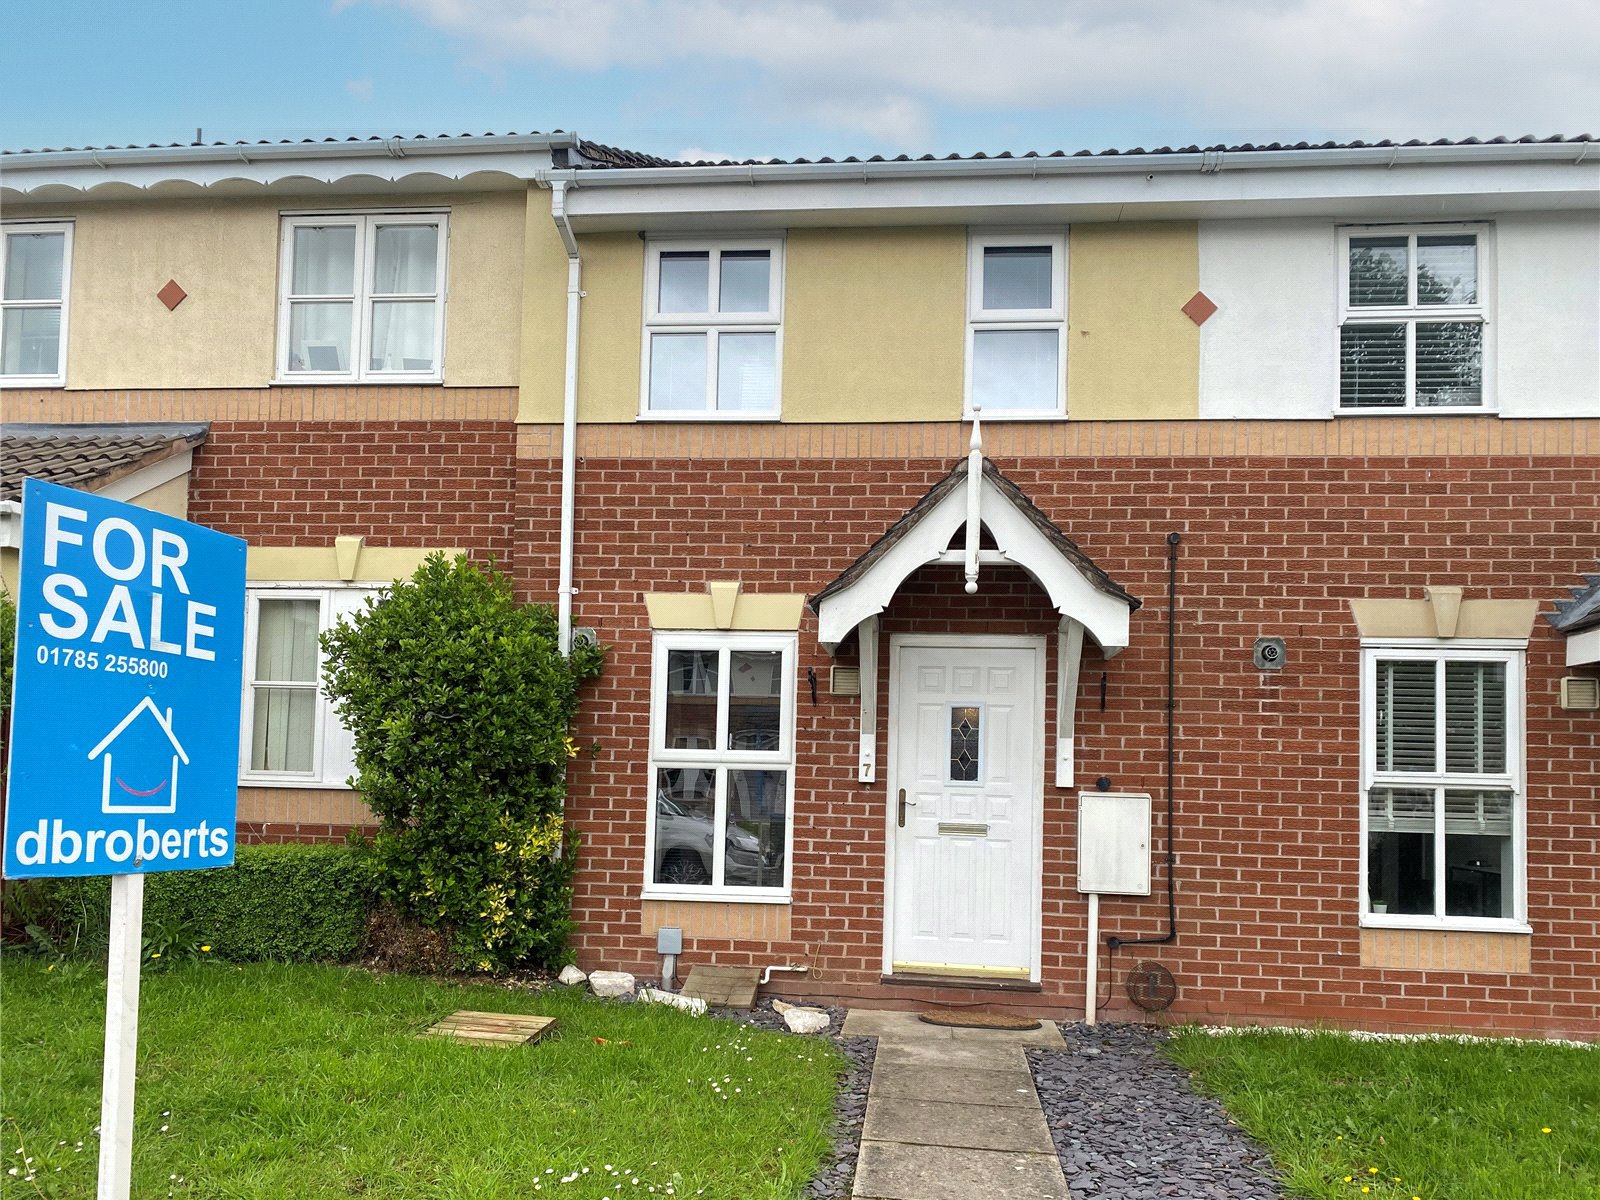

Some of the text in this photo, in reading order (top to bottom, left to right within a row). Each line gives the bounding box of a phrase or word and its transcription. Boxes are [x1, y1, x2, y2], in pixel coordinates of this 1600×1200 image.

[43, 501, 190, 595] FOR
[39, 573, 217, 661] SALE
[36, 645, 168, 679] 01785 255800
[862, 763, 872, 777] 7
[15, 819, 229, 865] dbroberts
